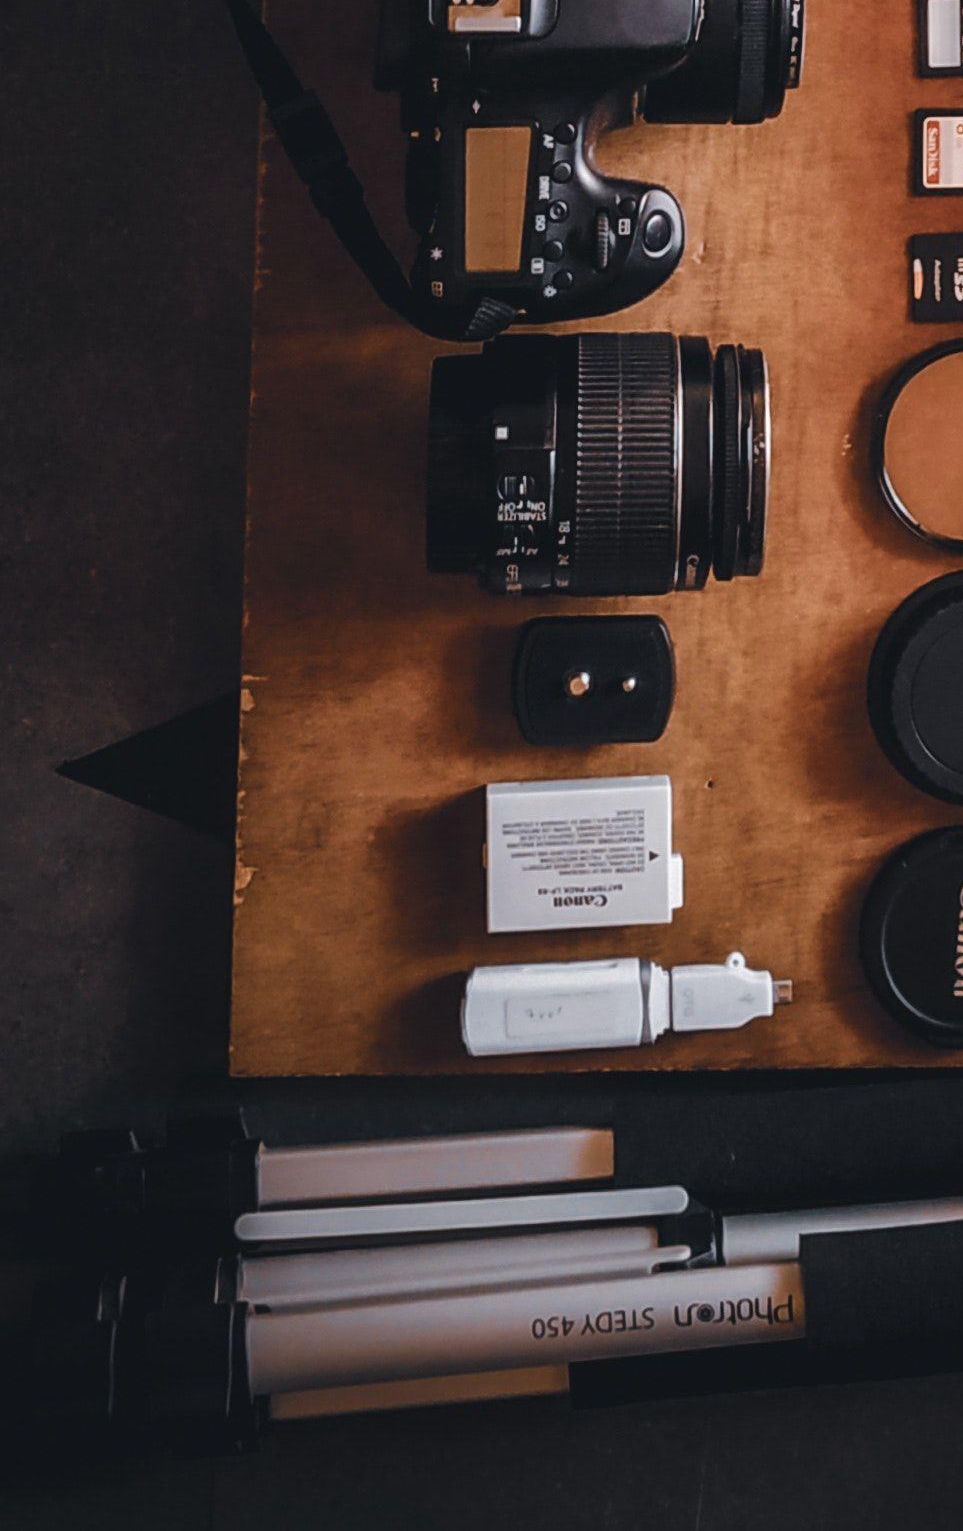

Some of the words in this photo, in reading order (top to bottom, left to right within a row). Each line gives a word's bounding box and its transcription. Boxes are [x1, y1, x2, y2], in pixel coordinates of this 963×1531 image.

[927, 127, 939, 178] SanDisk
[539, 176, 550, 199] DRIVE
[535, 214, 546, 231] ISO
[563, 886, 585, 894] PACK
[586, 884, 623, 893] BATTERY
[553, 894, 608, 908] Canon
[580, 1307, 655, 1337] STEDY
[674, 1295, 794, 1329] Photron
[531, 1316, 575, 1340] 450
